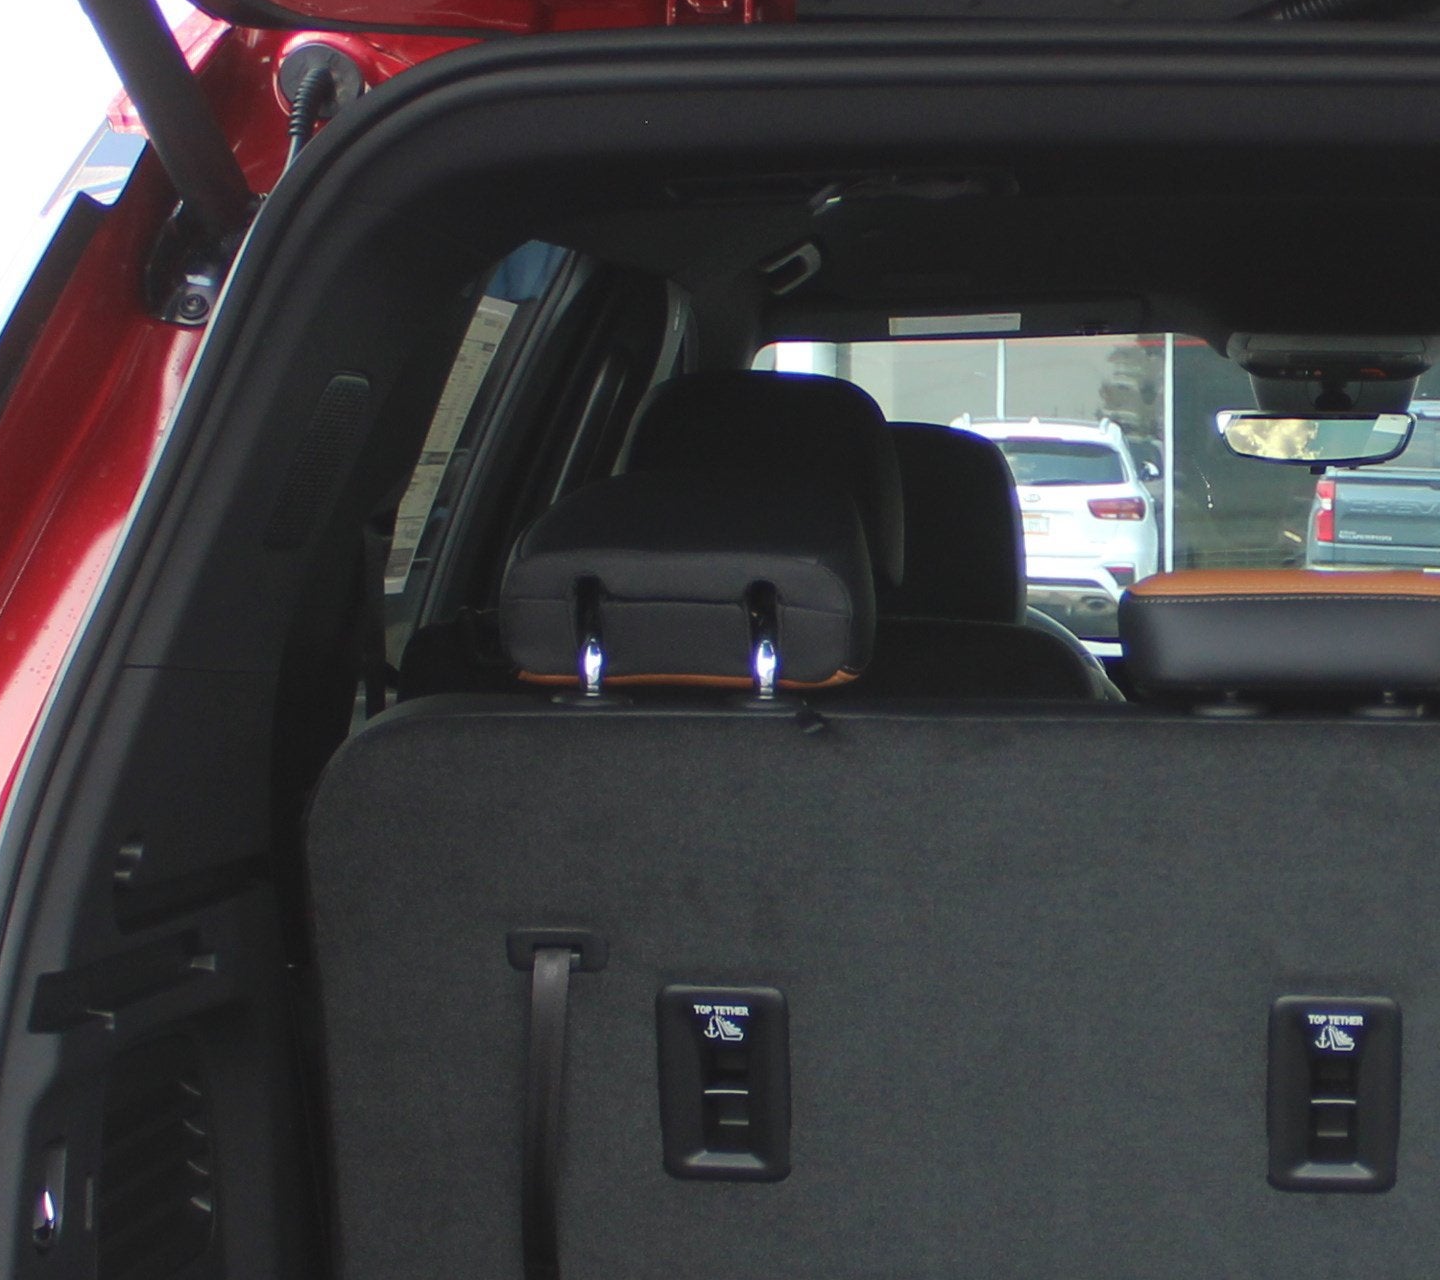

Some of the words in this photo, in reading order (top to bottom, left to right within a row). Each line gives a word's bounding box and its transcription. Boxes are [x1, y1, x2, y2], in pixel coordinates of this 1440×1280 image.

[693, 1004, 712, 1015] TOP
[713, 1005, 749, 1017] TETHER
[1308, 1014, 1327, 1025] TOP
[1328, 1014, 1363, 1026] TETHER
